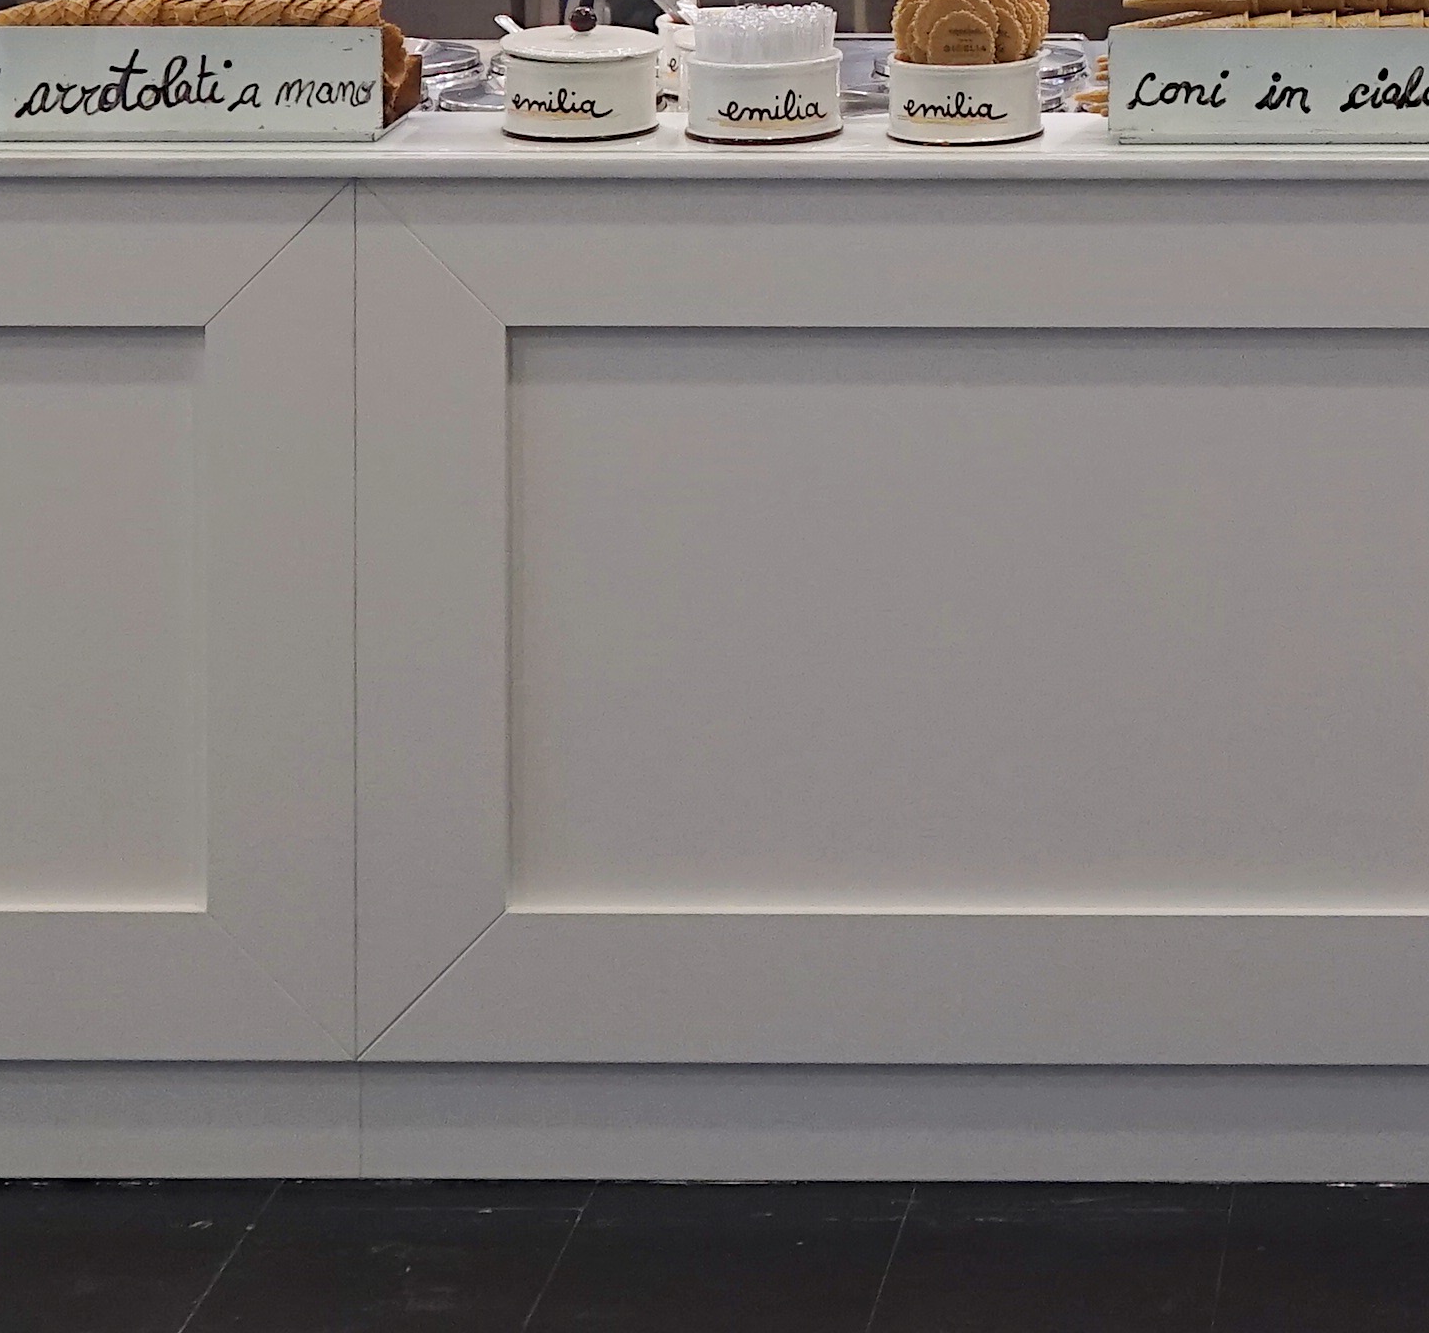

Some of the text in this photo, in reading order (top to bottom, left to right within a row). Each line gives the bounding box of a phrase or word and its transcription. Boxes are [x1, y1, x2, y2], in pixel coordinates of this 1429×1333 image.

[228, 81, 263, 112] a
[275, 78, 376, 112] mano
[511, 81, 614, 120] emilia
[717, 90, 828, 123] emilia
[903, 84, 1008, 120] emilia
[1125, 69, 1231, 110] Coni
[1255, 71, 1313, 114] in
